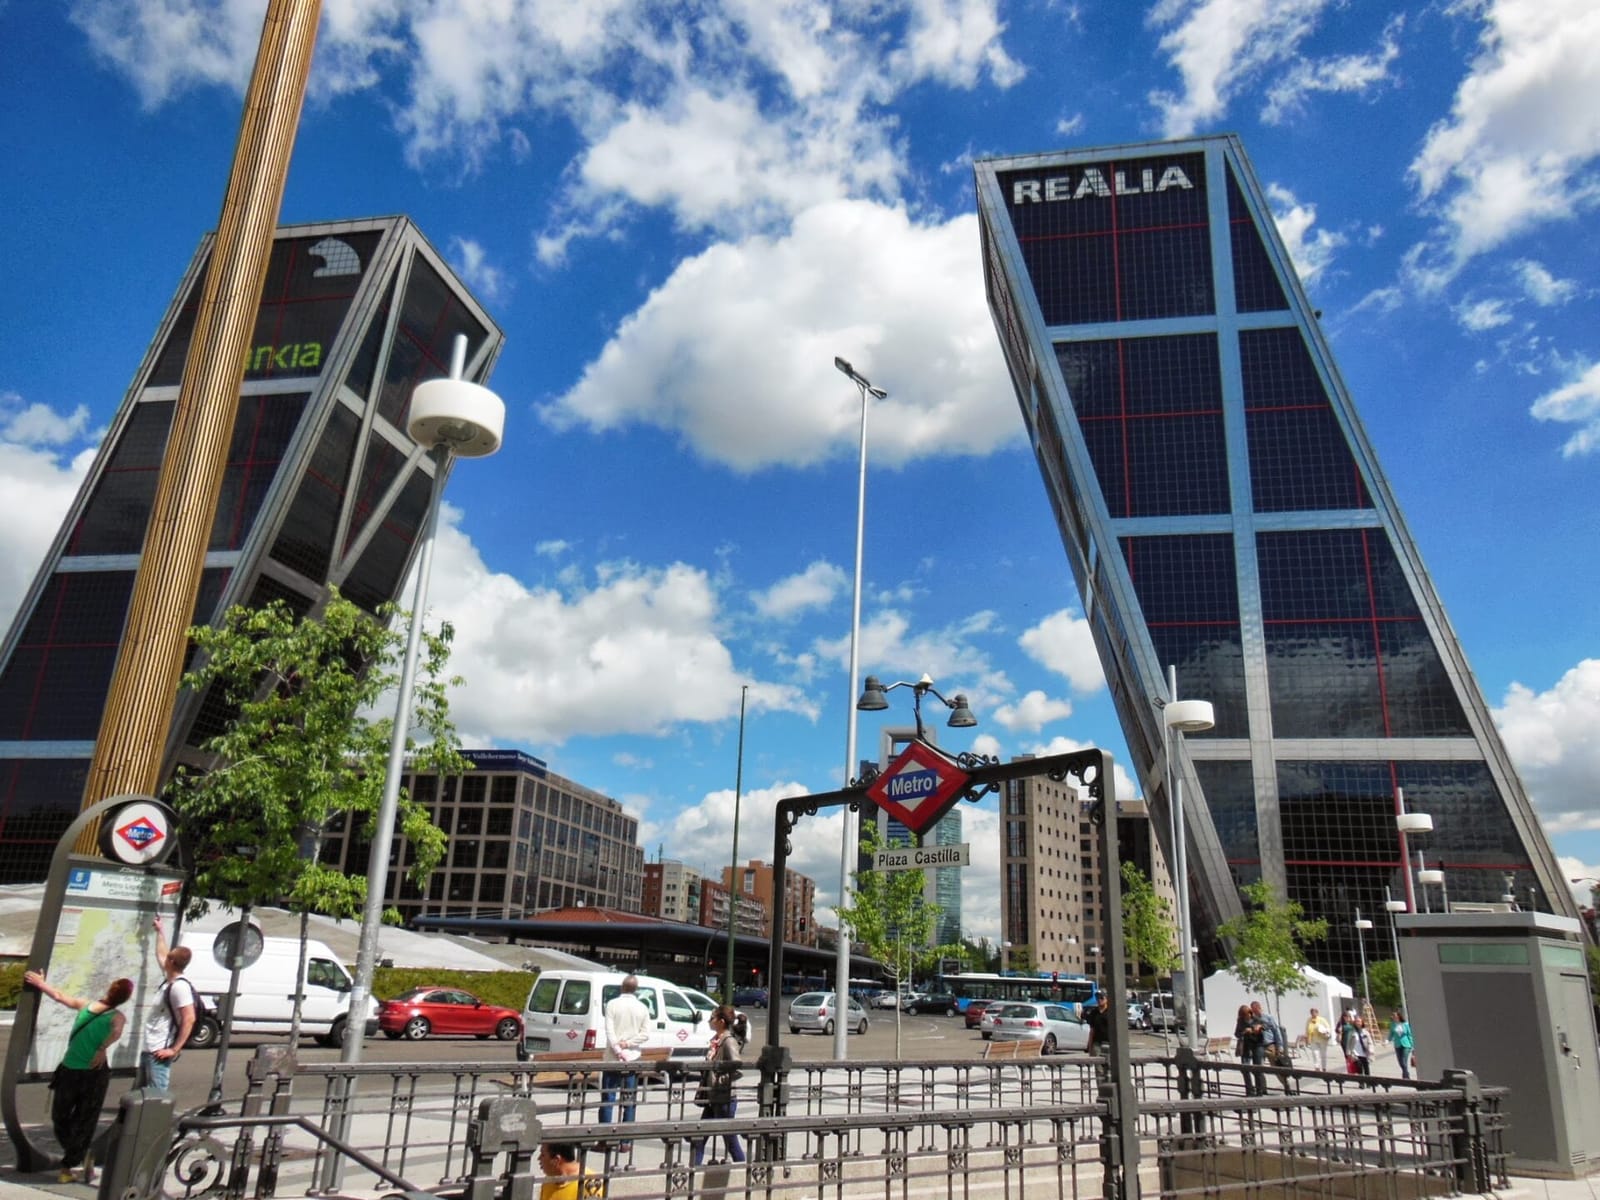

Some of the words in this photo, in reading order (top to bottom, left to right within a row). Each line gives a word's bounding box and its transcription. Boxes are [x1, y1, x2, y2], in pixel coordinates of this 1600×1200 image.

[1013, 165, 1194, 205] REALIA
[891, 776, 933, 796] Metro
[127, 827, 154, 840] Metro
[878, 854, 908, 867] Plaza
[914, 848, 960, 865] Castilla
